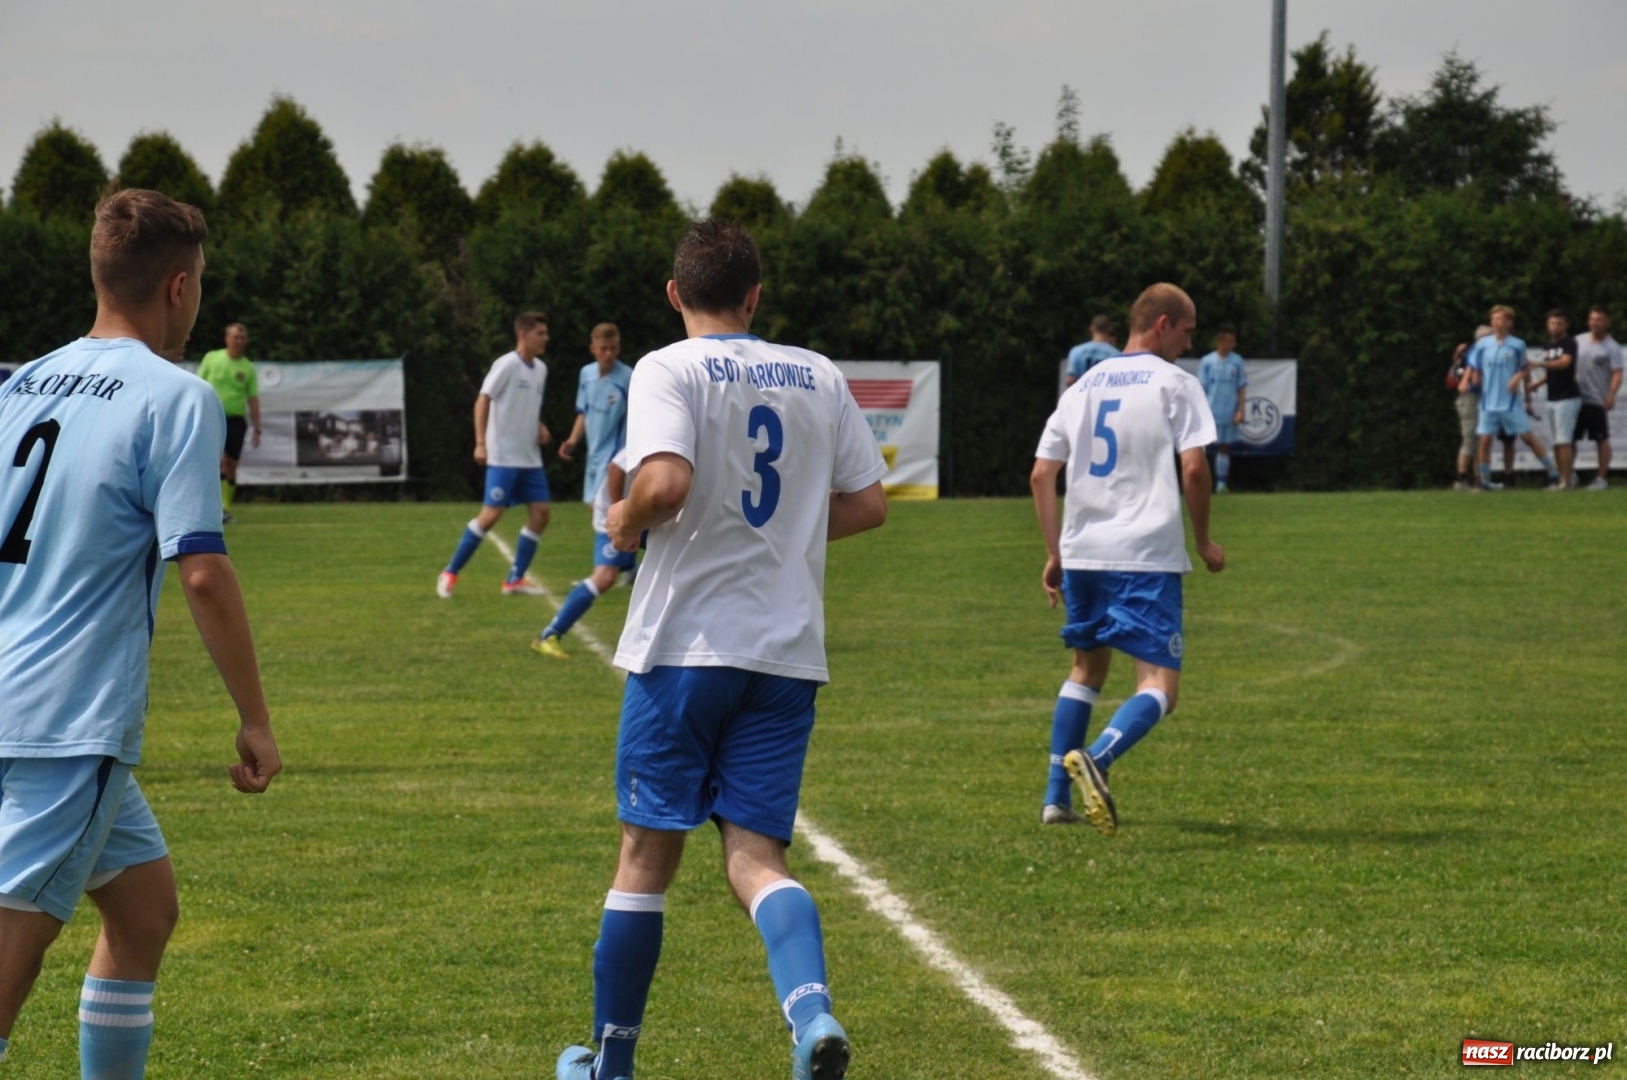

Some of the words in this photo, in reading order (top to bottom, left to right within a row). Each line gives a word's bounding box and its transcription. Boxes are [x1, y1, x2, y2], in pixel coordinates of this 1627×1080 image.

[0, 418, 61, 564] 2
[742, 405, 783, 528] 3
[1089, 399, 1121, 477] 5
